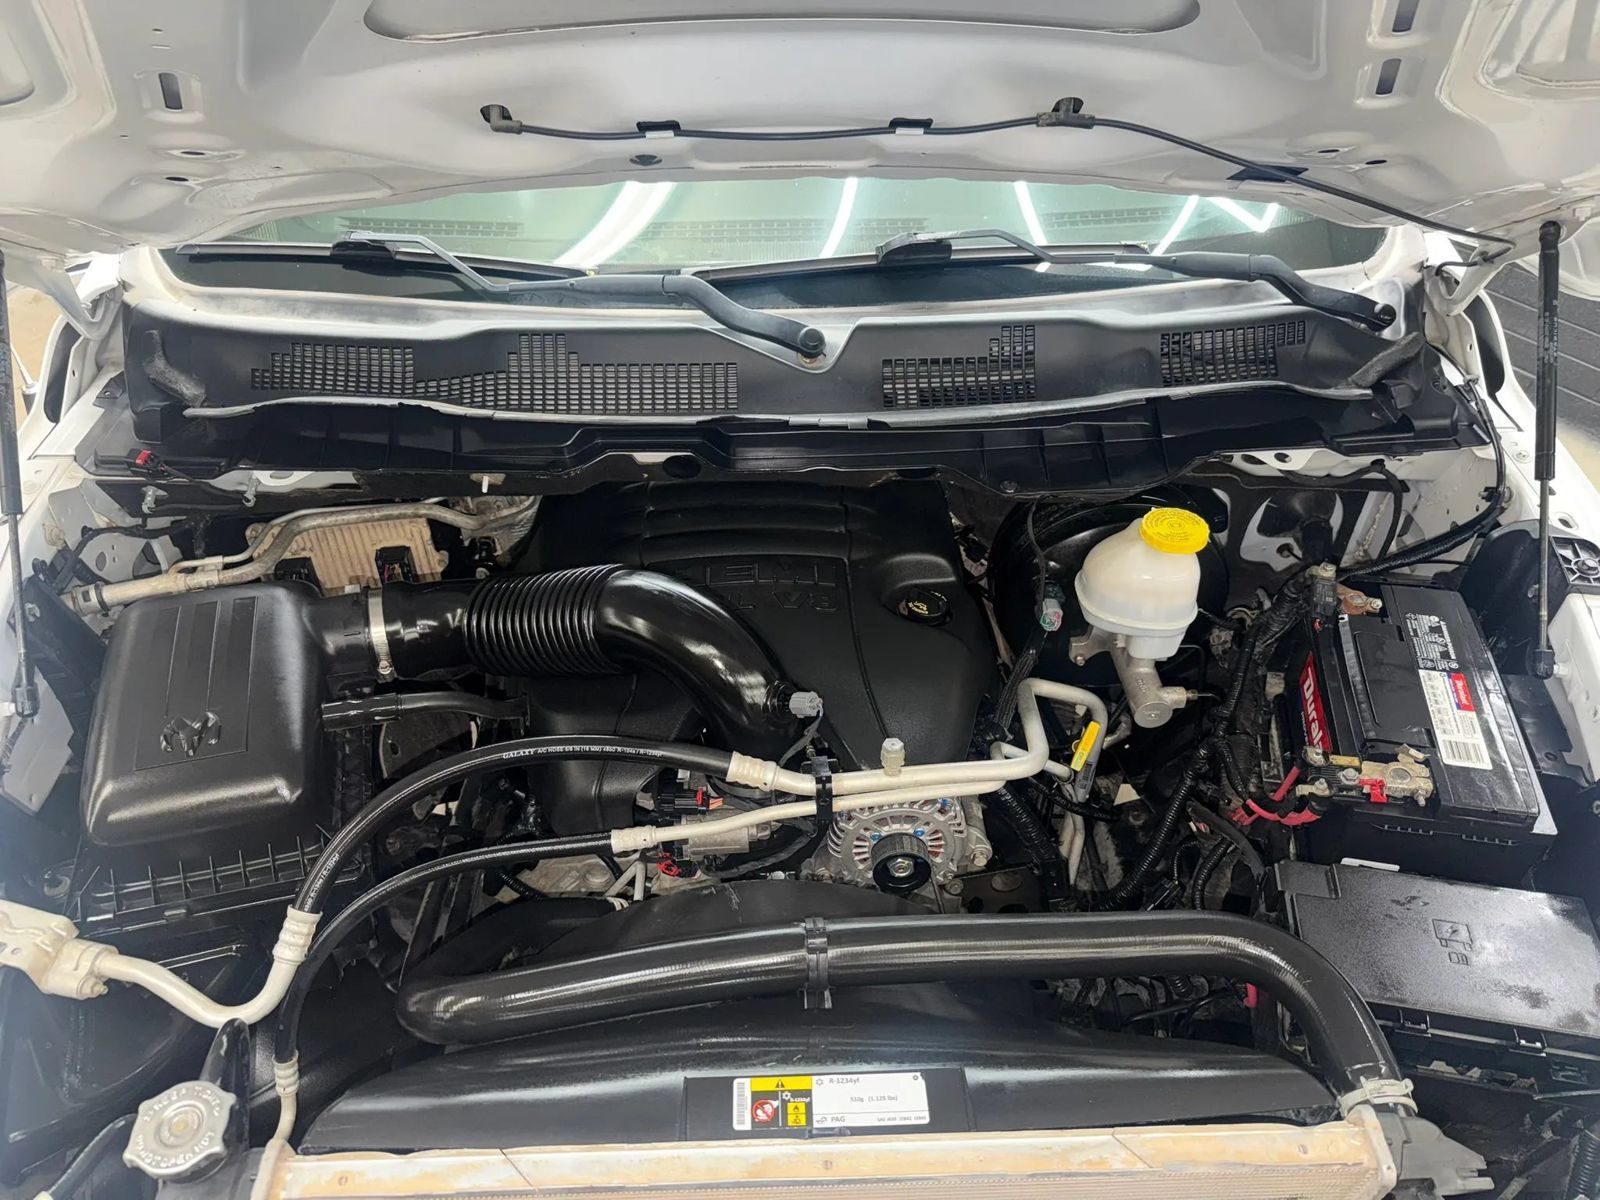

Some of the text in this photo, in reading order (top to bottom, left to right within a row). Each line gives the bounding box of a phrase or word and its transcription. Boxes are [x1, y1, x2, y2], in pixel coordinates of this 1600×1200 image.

[1303, 667, 1323, 753] Dural
[503, 748, 534, 759] GALAXY
[829, 1077, 860, 1086] R-1234yf
[831, 1115, 846, 1123] PAG
[160, 1153, 193, 1168] OPEN
